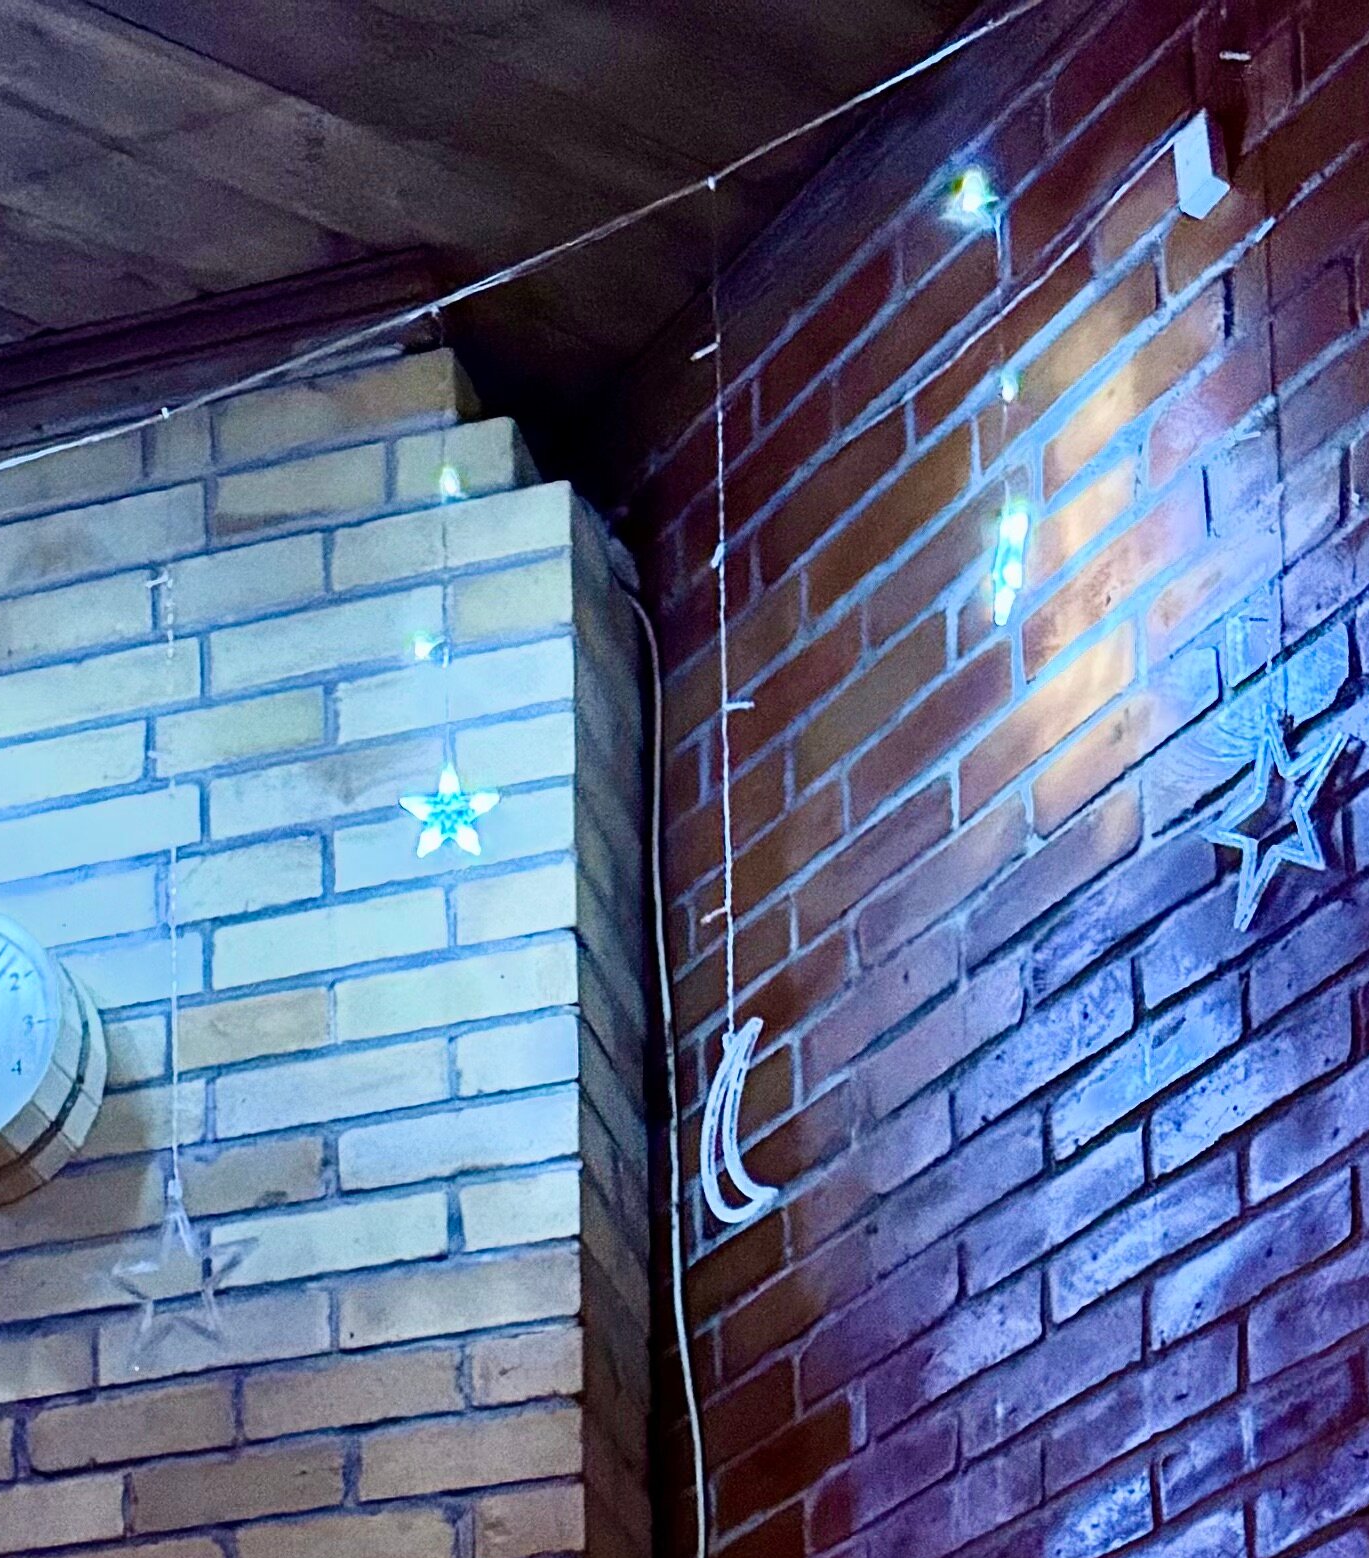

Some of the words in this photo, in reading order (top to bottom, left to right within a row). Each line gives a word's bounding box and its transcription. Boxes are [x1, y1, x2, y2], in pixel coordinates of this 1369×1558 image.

[9, 972, 20, 991] 2
[23, 1014, 35, 1035] 3
[11, 1059, 22, 1076] 4
